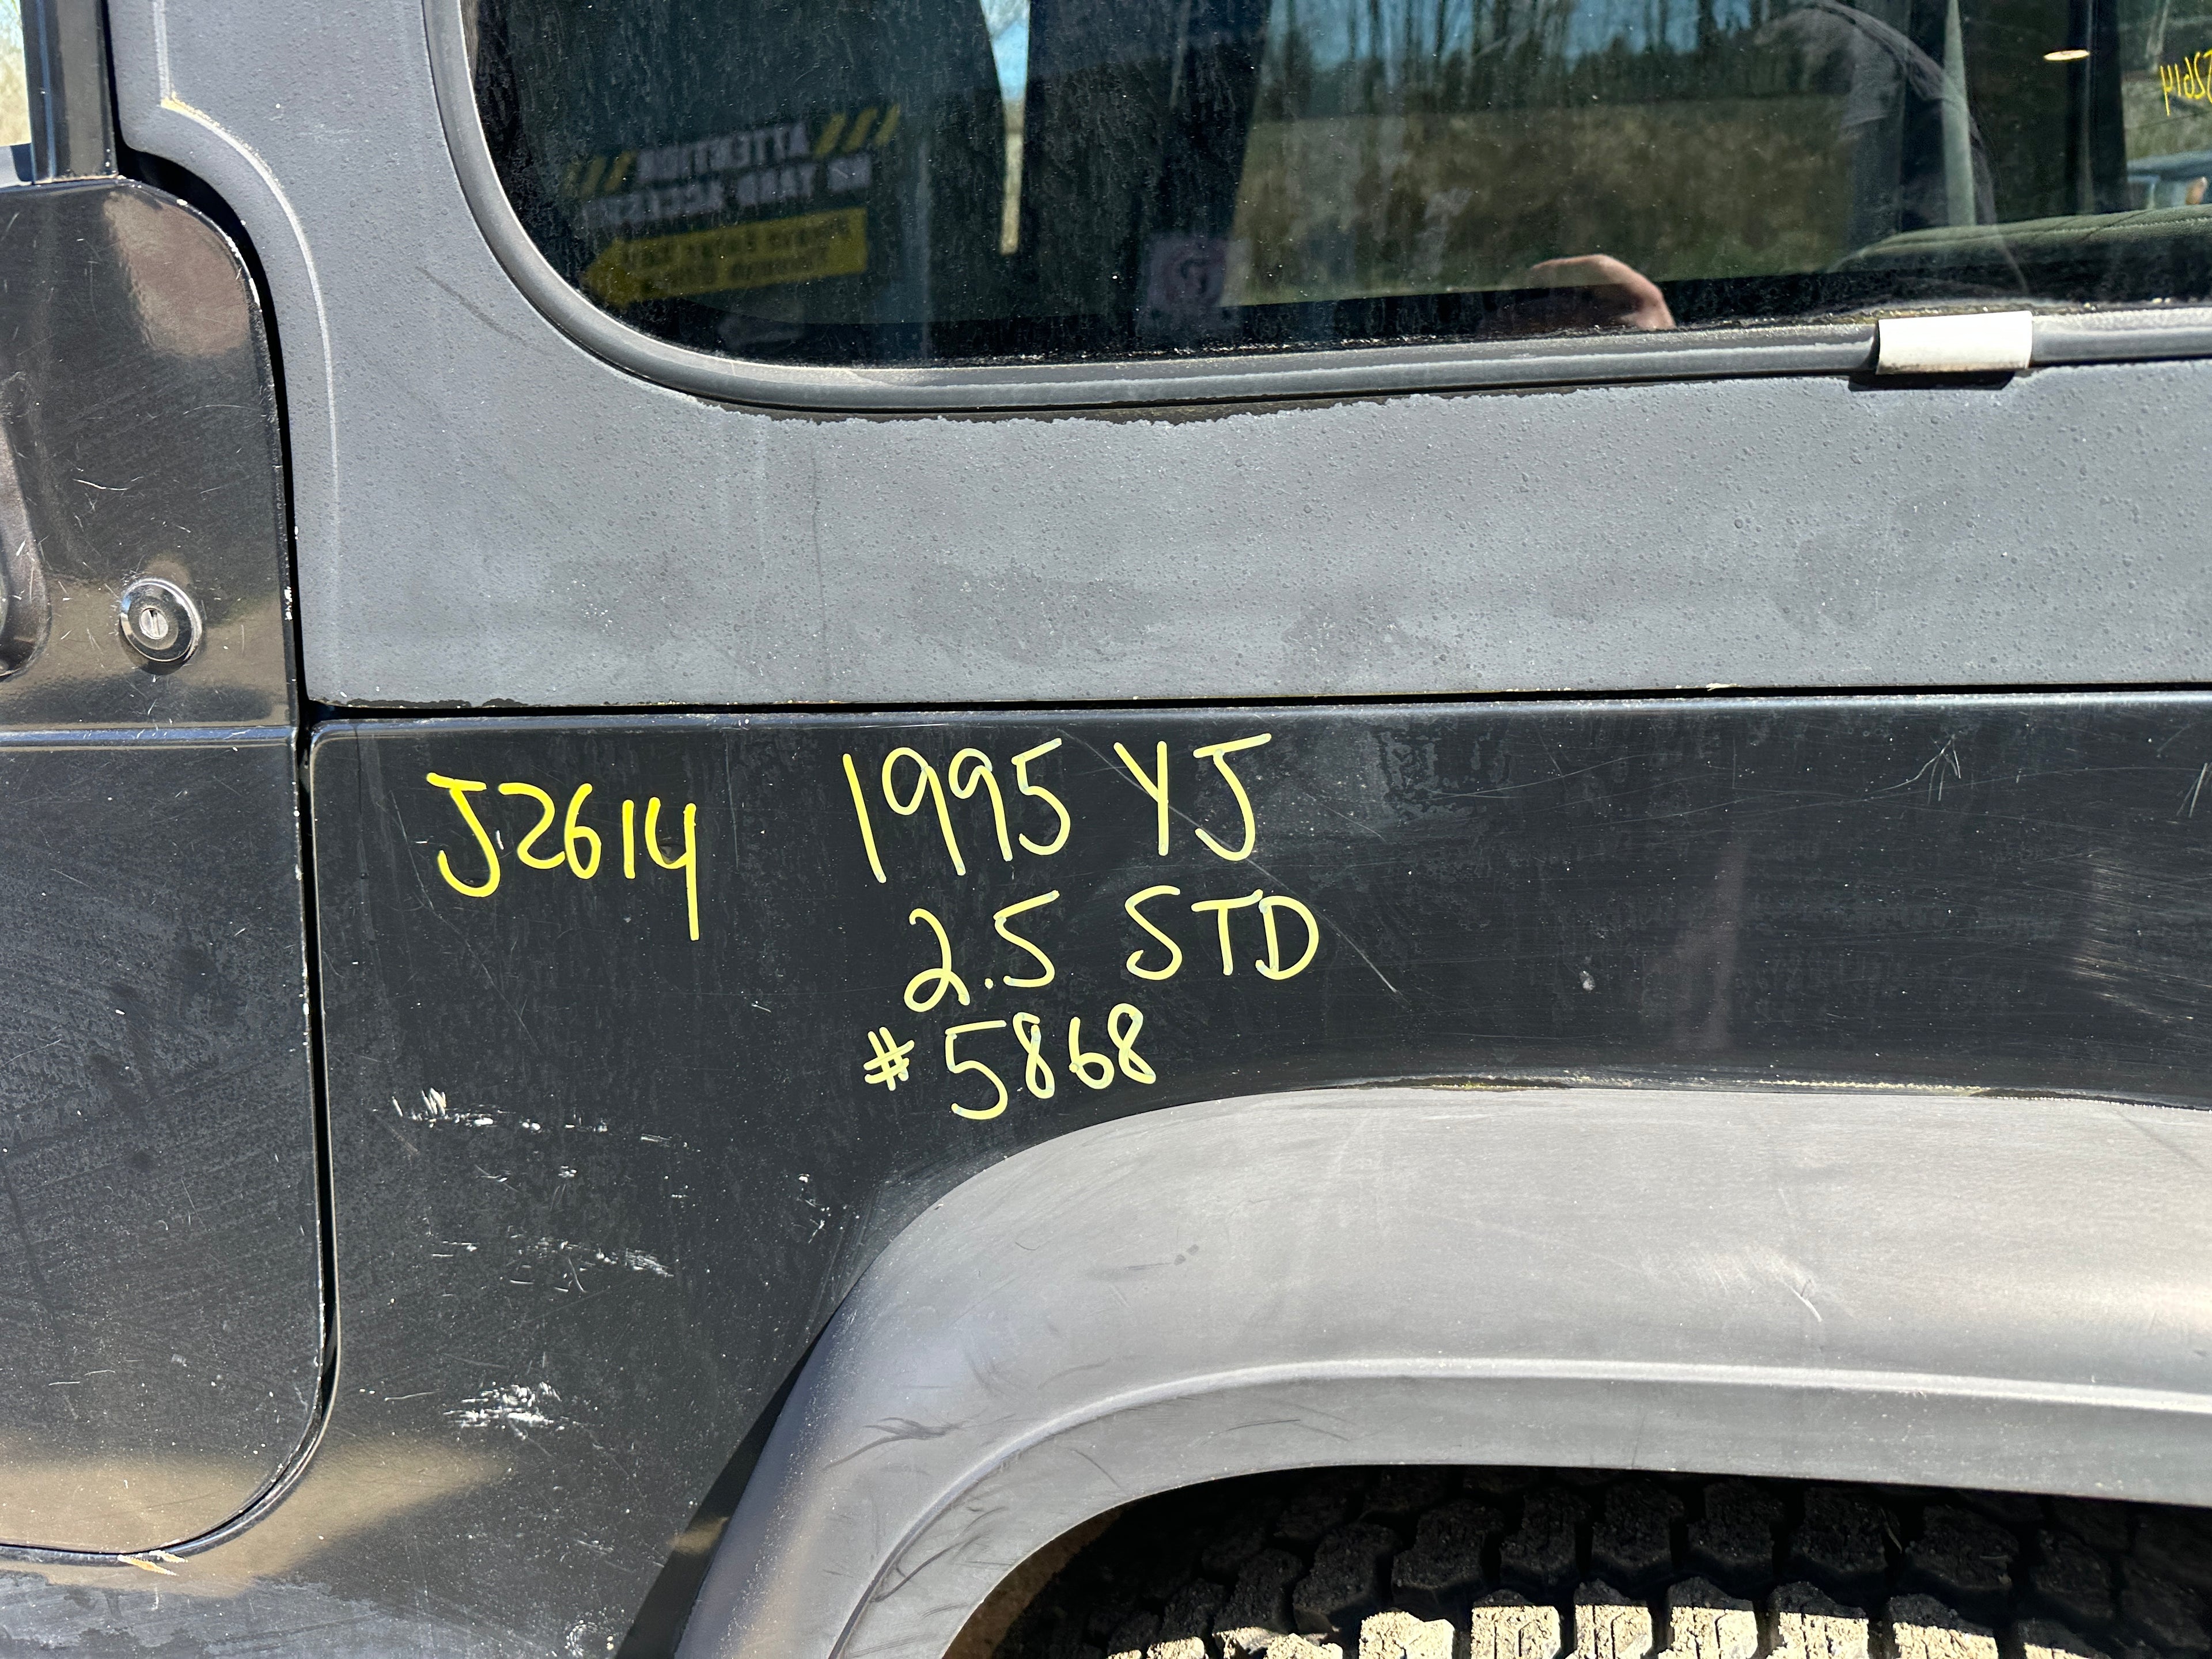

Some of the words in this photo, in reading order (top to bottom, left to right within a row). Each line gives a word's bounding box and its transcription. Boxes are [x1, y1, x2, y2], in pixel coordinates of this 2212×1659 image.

[425, 771, 700, 941] J2614
[842, 736, 1071, 884] 1995
[1113, 733, 1272, 862] YJ
[903, 889, 1060, 1014] 2.5
[1124, 886, 1320, 982] STD
